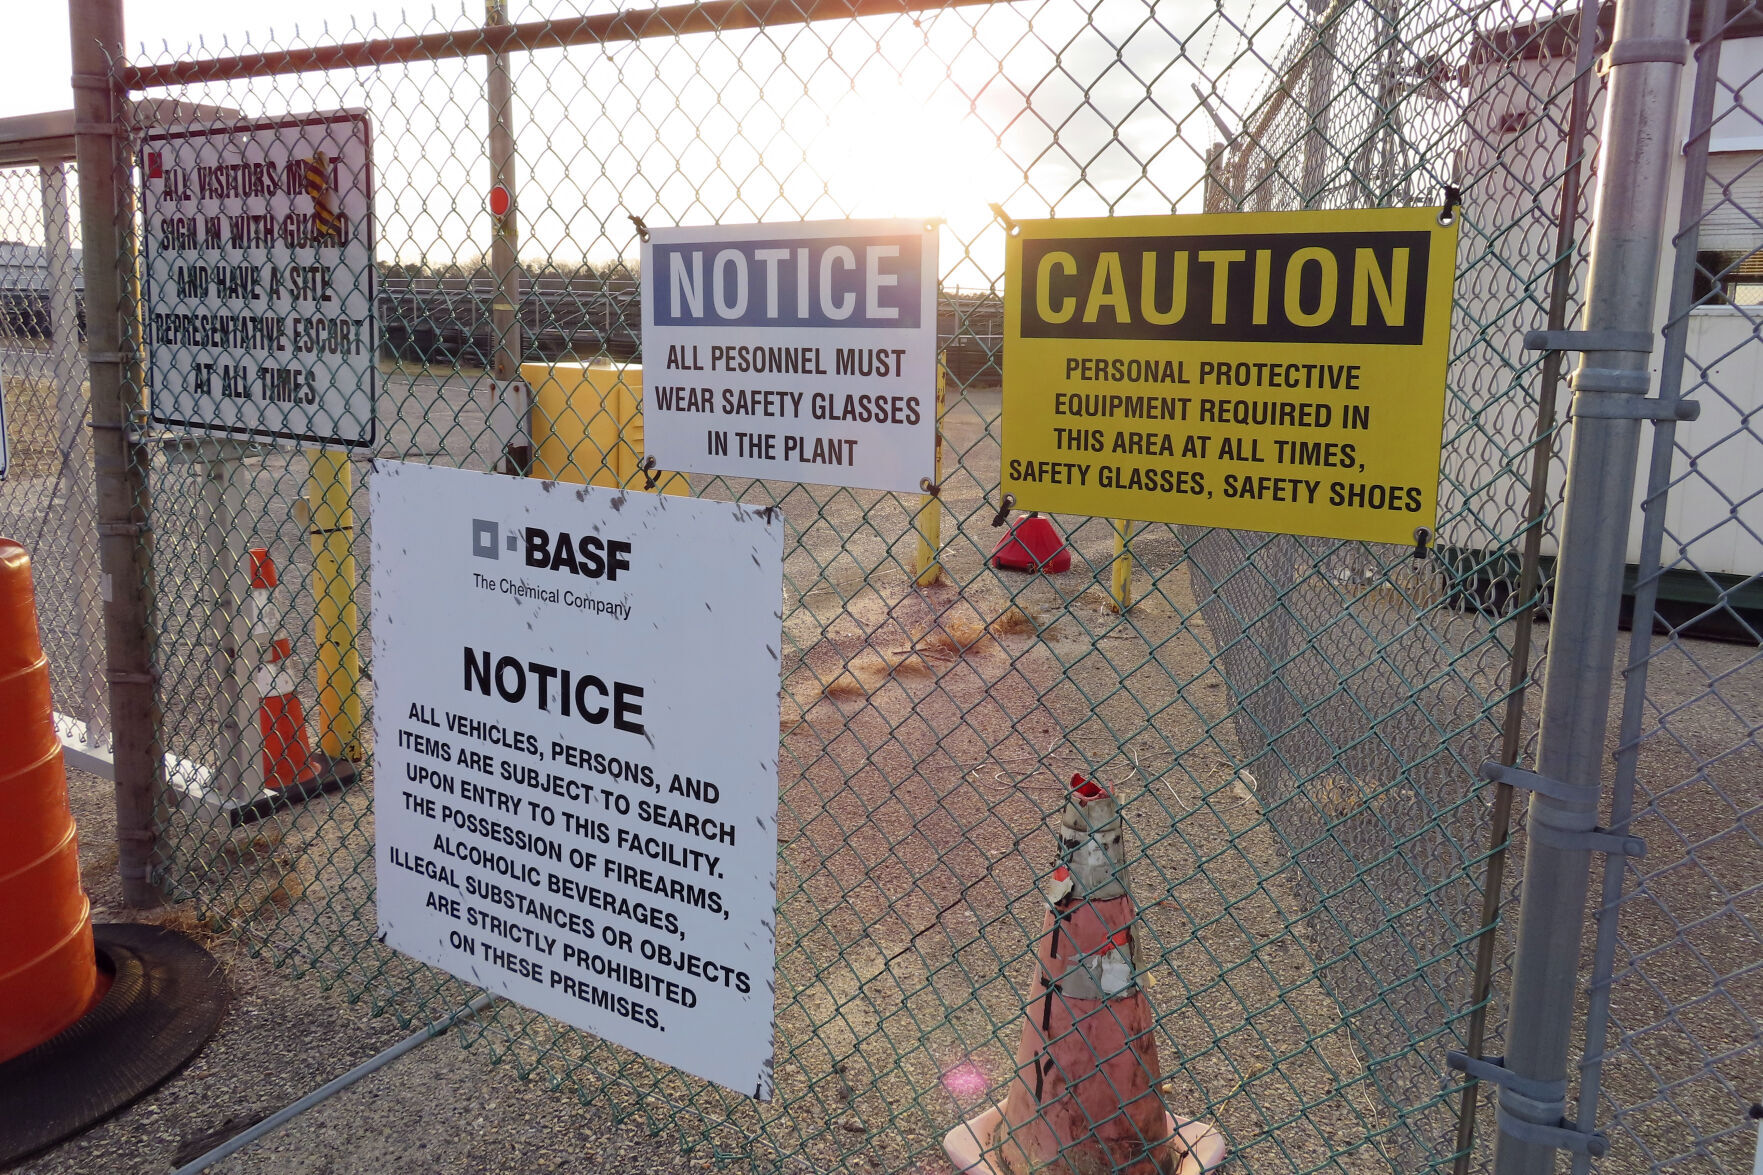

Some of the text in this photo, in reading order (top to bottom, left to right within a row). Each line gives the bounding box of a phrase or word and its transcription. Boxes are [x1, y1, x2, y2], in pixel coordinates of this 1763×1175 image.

[163, 156, 341, 201] ALL VISITORS MT
[161, 217, 197, 250] SIGN
[205, 216, 221, 250] IN
[229, 213, 275, 249] WITH
[177, 266, 332, 302] AND HAVE A SITE
[669, 245, 900, 320] NOTICE
[1036, 246, 1410, 327] CAUTION
[155, 312, 364, 356] REPRESENTATIVE ESCORT
[194, 363, 317, 406] AT ALL TIMES
[666, 345, 906, 377] ALL PESONNEL MUST
[1065, 358, 1361, 390] PERSONAL PROTECTIVE
[655, 386, 921, 426] WEAR SAFETY GLASSES
[1055, 393, 1370, 430] EQUIPMENT REQUIRED IN
[707, 430, 858, 467] IN THE PLANT
[1053, 427, 1366, 473] THIS AREA AT ALL TIMES,
[1009, 460, 1423, 513] SAFETY GLASSES, SAFETY SHOES
[525, 526, 632, 582] BASF
[473, 572, 632, 621] The Chemical Company
[463, 646, 645, 736] NOTICE
[408, 702, 720, 805] ALL VEHICLES, PERSONS, AND
[398, 729, 736, 847] ITEMS ARE SUBJECT TO SEARCH
[406, 762, 724, 879] UPON ENTRY TO THIS FACILITY.
[402, 791, 730, 921] THE POSSESSION OF FIREARMS,
[433, 833, 685, 942] ALCOHOLIC BEVERAGES,
[389, 846, 752, 995] ILLEGAL SUBSTANCES OR OBJECTS
[425, 891, 697, 1010] ARE STRICTLY PROHIBITED
[449, 930, 666, 1033] ON THESE PREMISES.
